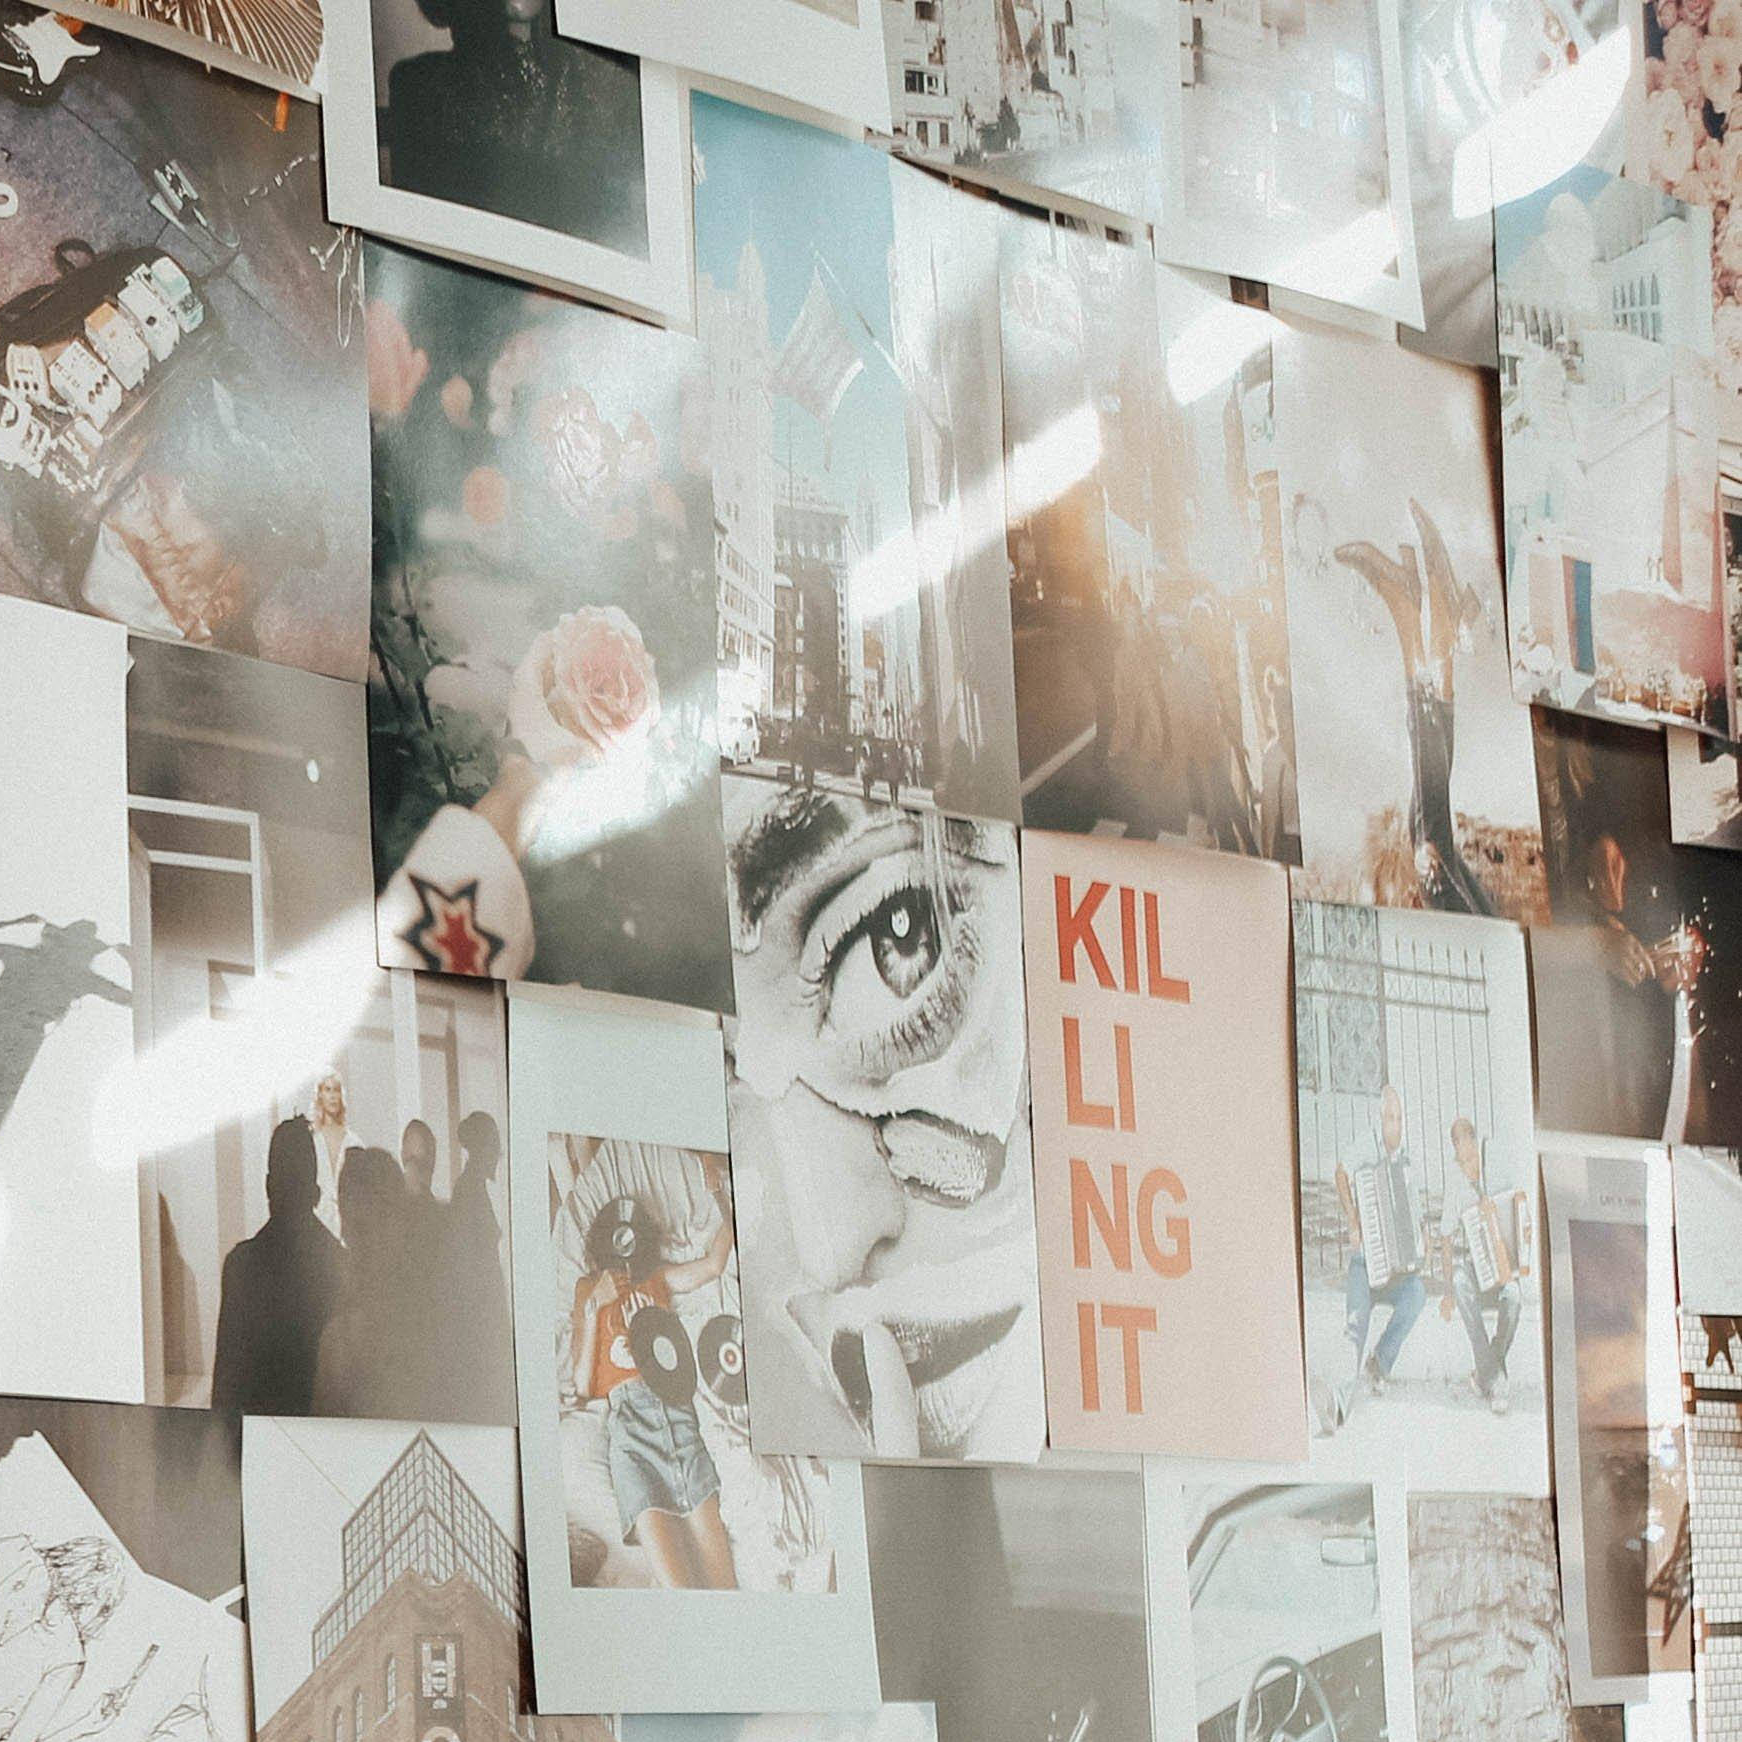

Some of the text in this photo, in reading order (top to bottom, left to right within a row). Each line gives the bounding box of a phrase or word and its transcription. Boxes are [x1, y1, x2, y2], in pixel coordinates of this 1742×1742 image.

[1054, 874, 1190, 1003] KIL
[1062, 1016, 1136, 1132] LI
[1071, 1160, 1192, 1279] NG
[1078, 1302, 1157, 1414] IT
